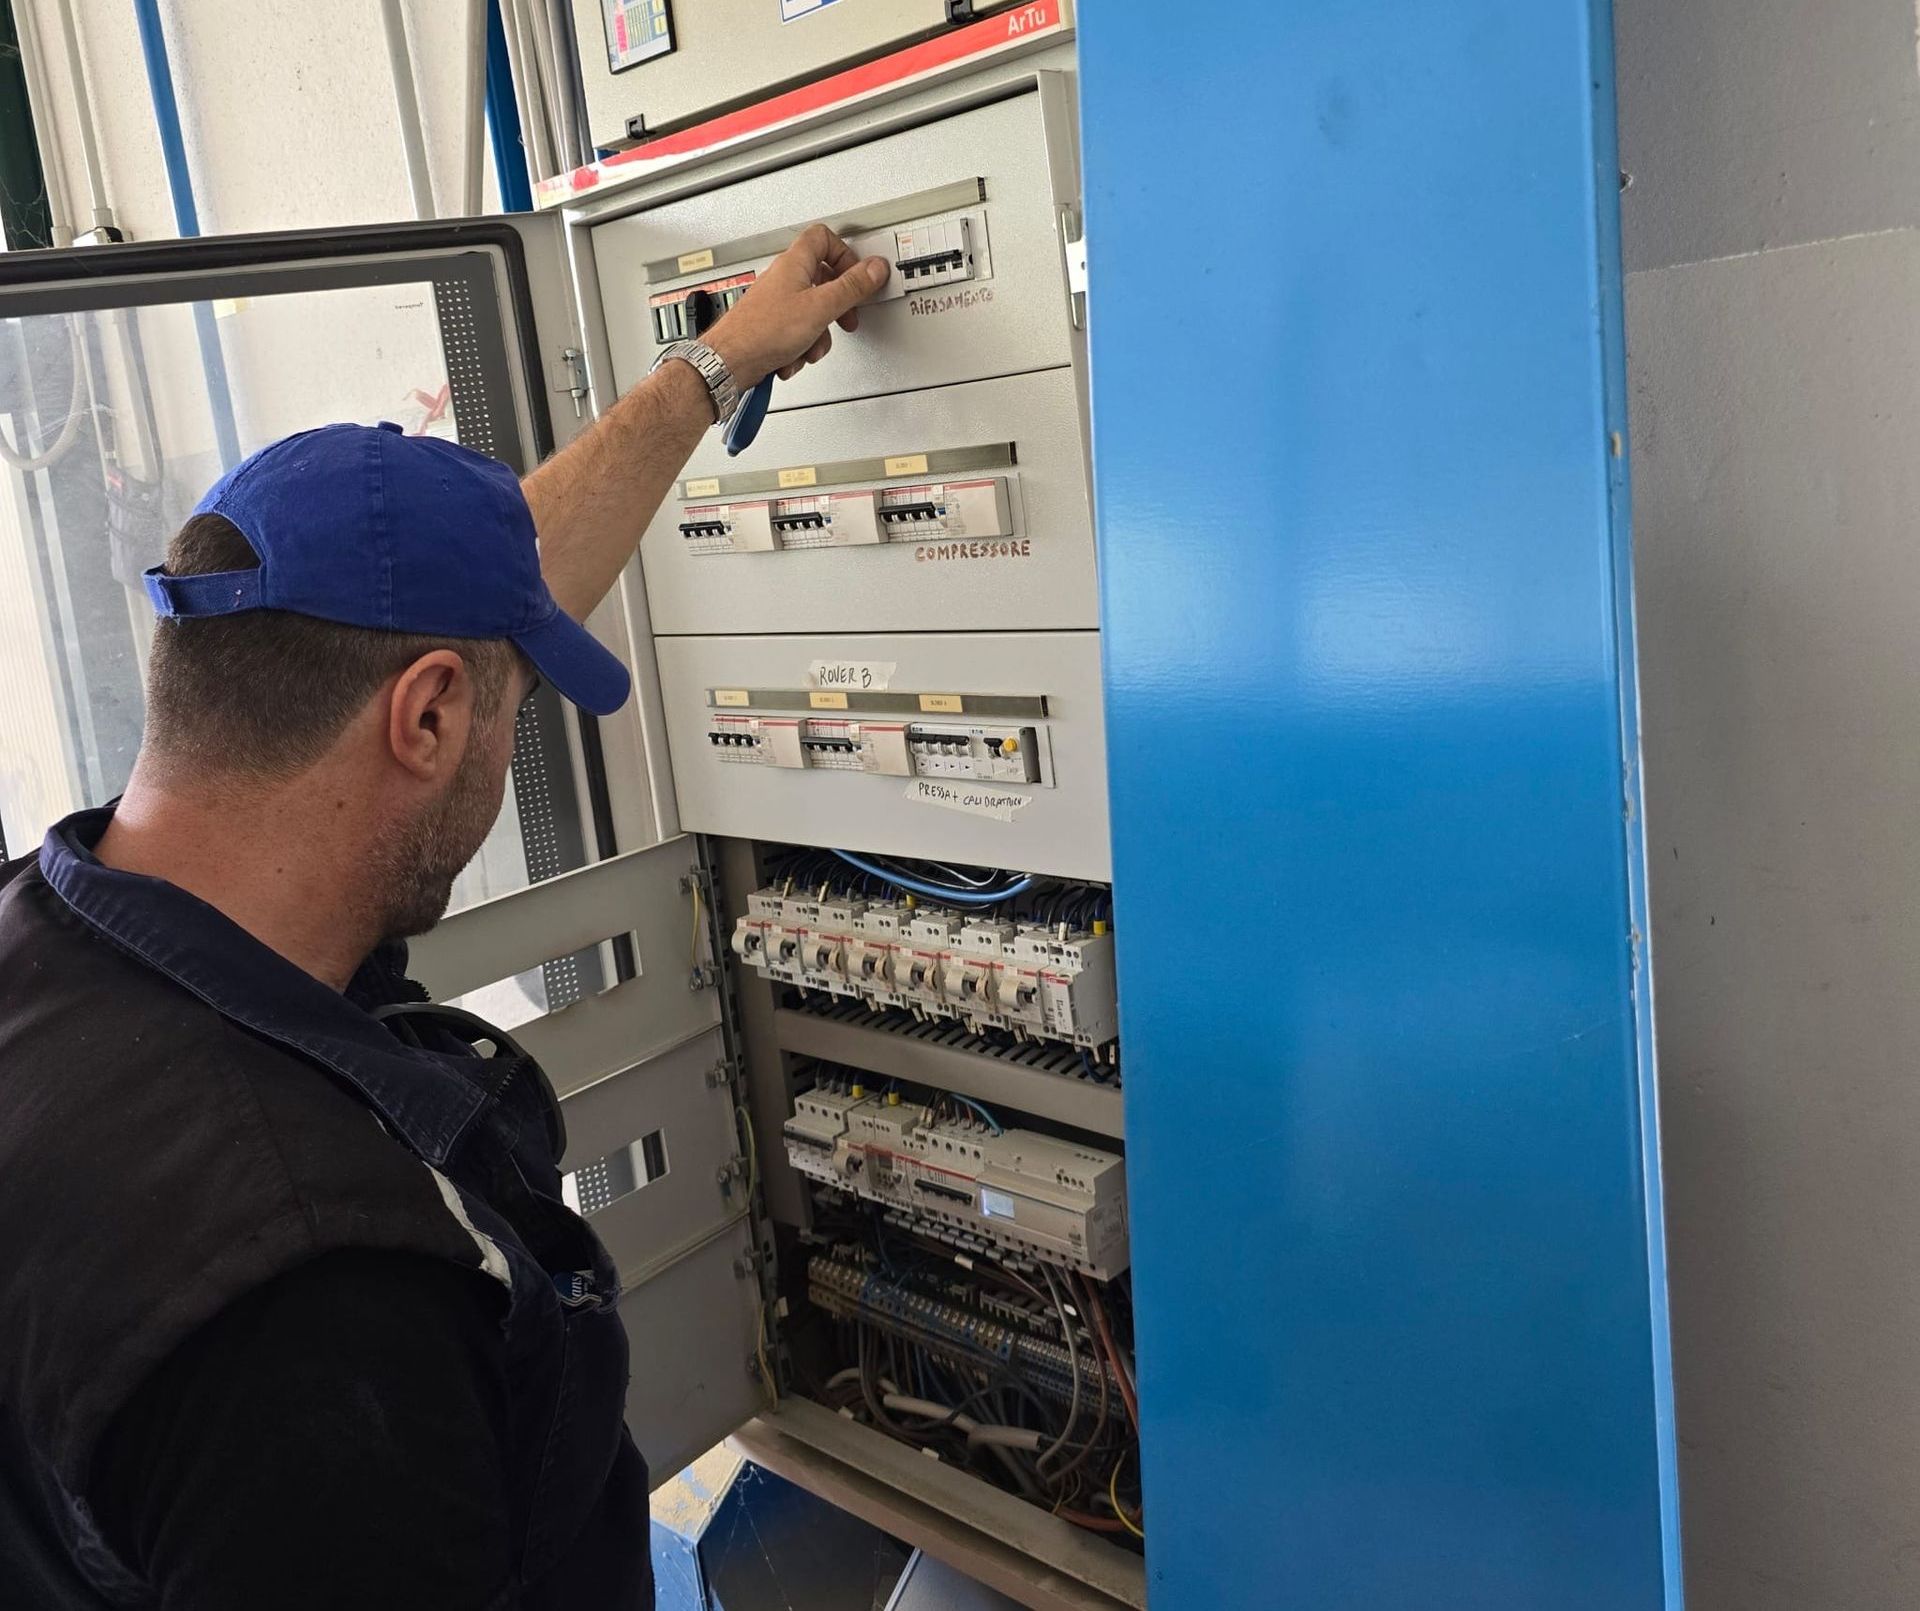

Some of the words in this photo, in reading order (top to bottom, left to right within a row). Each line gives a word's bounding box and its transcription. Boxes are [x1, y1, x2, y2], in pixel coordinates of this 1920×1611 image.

[1007, 7, 1046, 36] ArTu
[915, 539, 1030, 562] COMPRESSORE
[820, 665, 857, 685] ROVER
[861, 668, 872, 688] B
